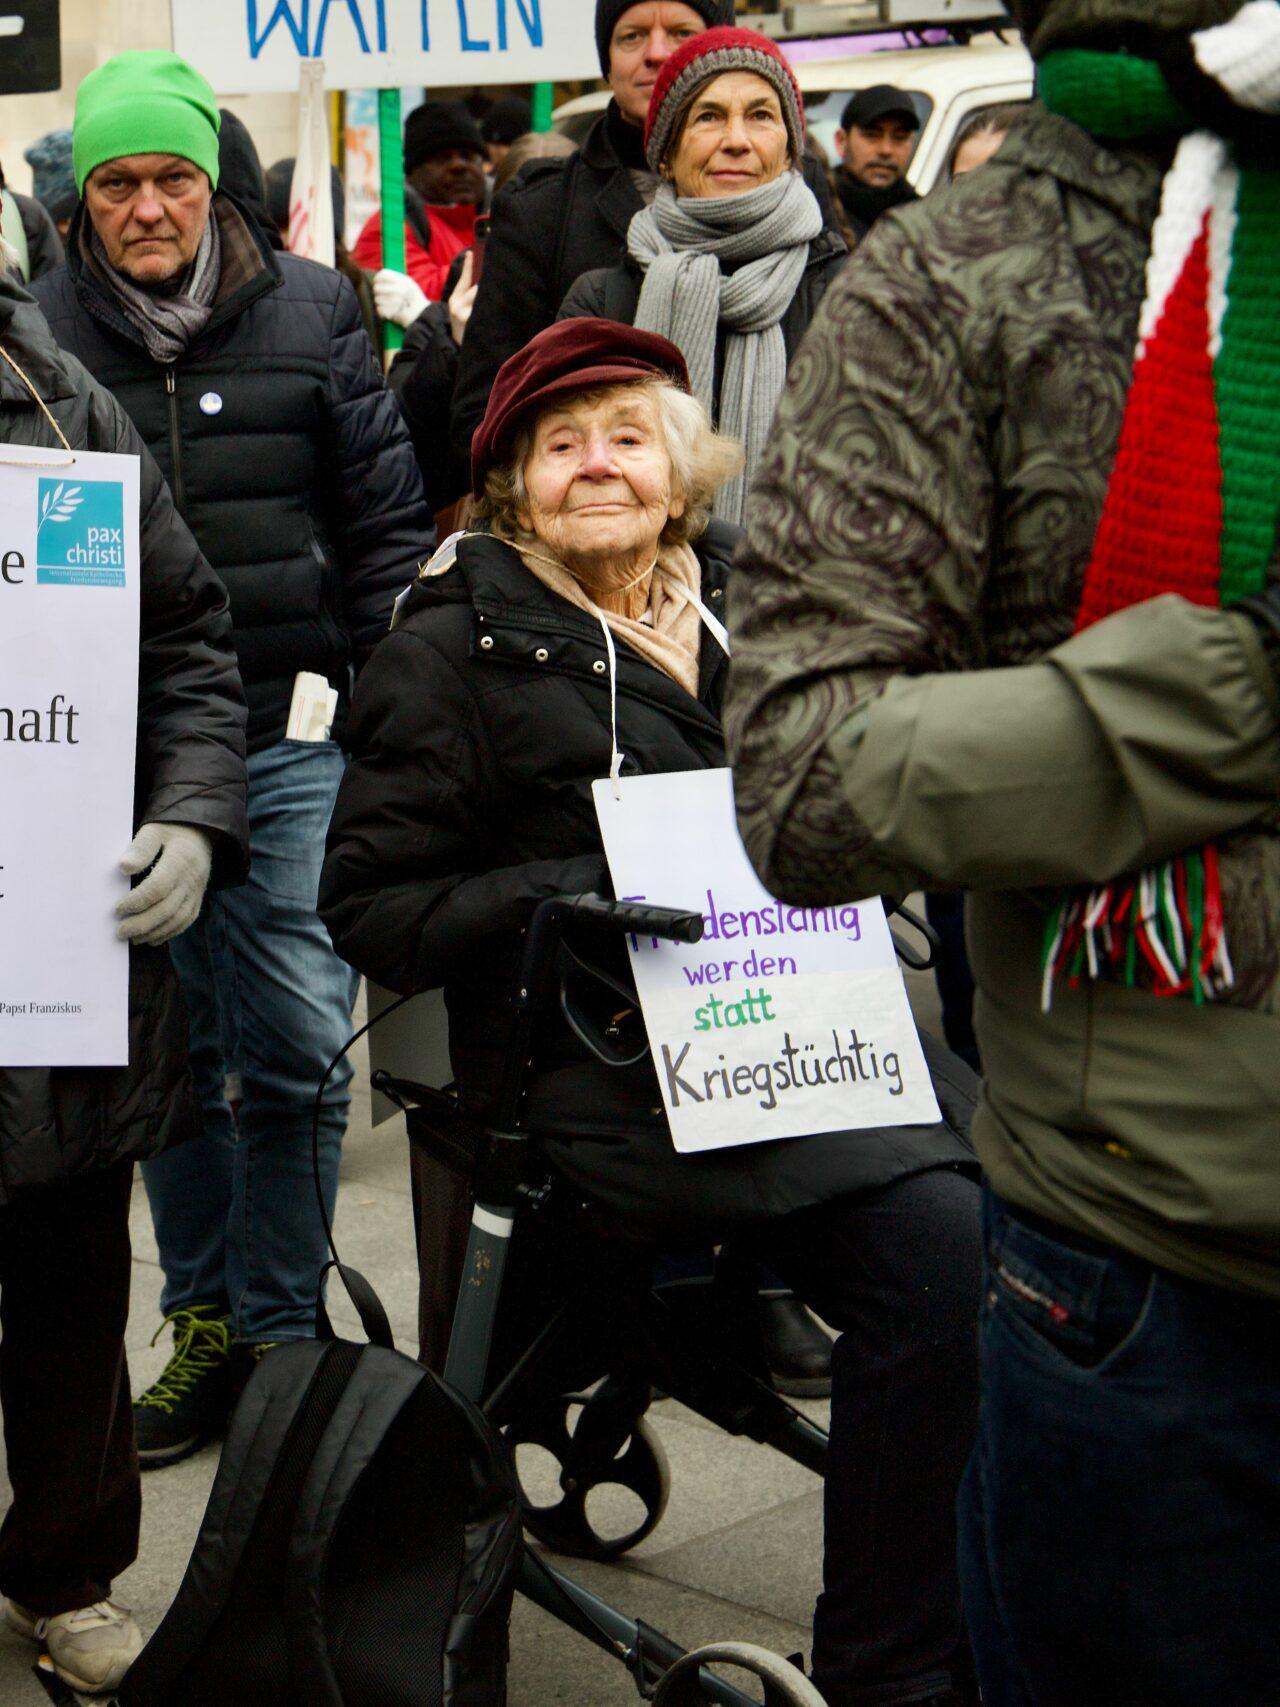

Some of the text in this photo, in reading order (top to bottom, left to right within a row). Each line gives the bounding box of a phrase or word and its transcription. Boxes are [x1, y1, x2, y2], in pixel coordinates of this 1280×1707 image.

[87, 526, 122, 548] pax
[66, 542, 122, 565] christi
[683, 949, 798, 987] werden
[29, 1002, 83, 1015] Franziskus
[693, 988, 776, 1032] statt
[661, 1028, 904, 1110] Kriegstüchtig
